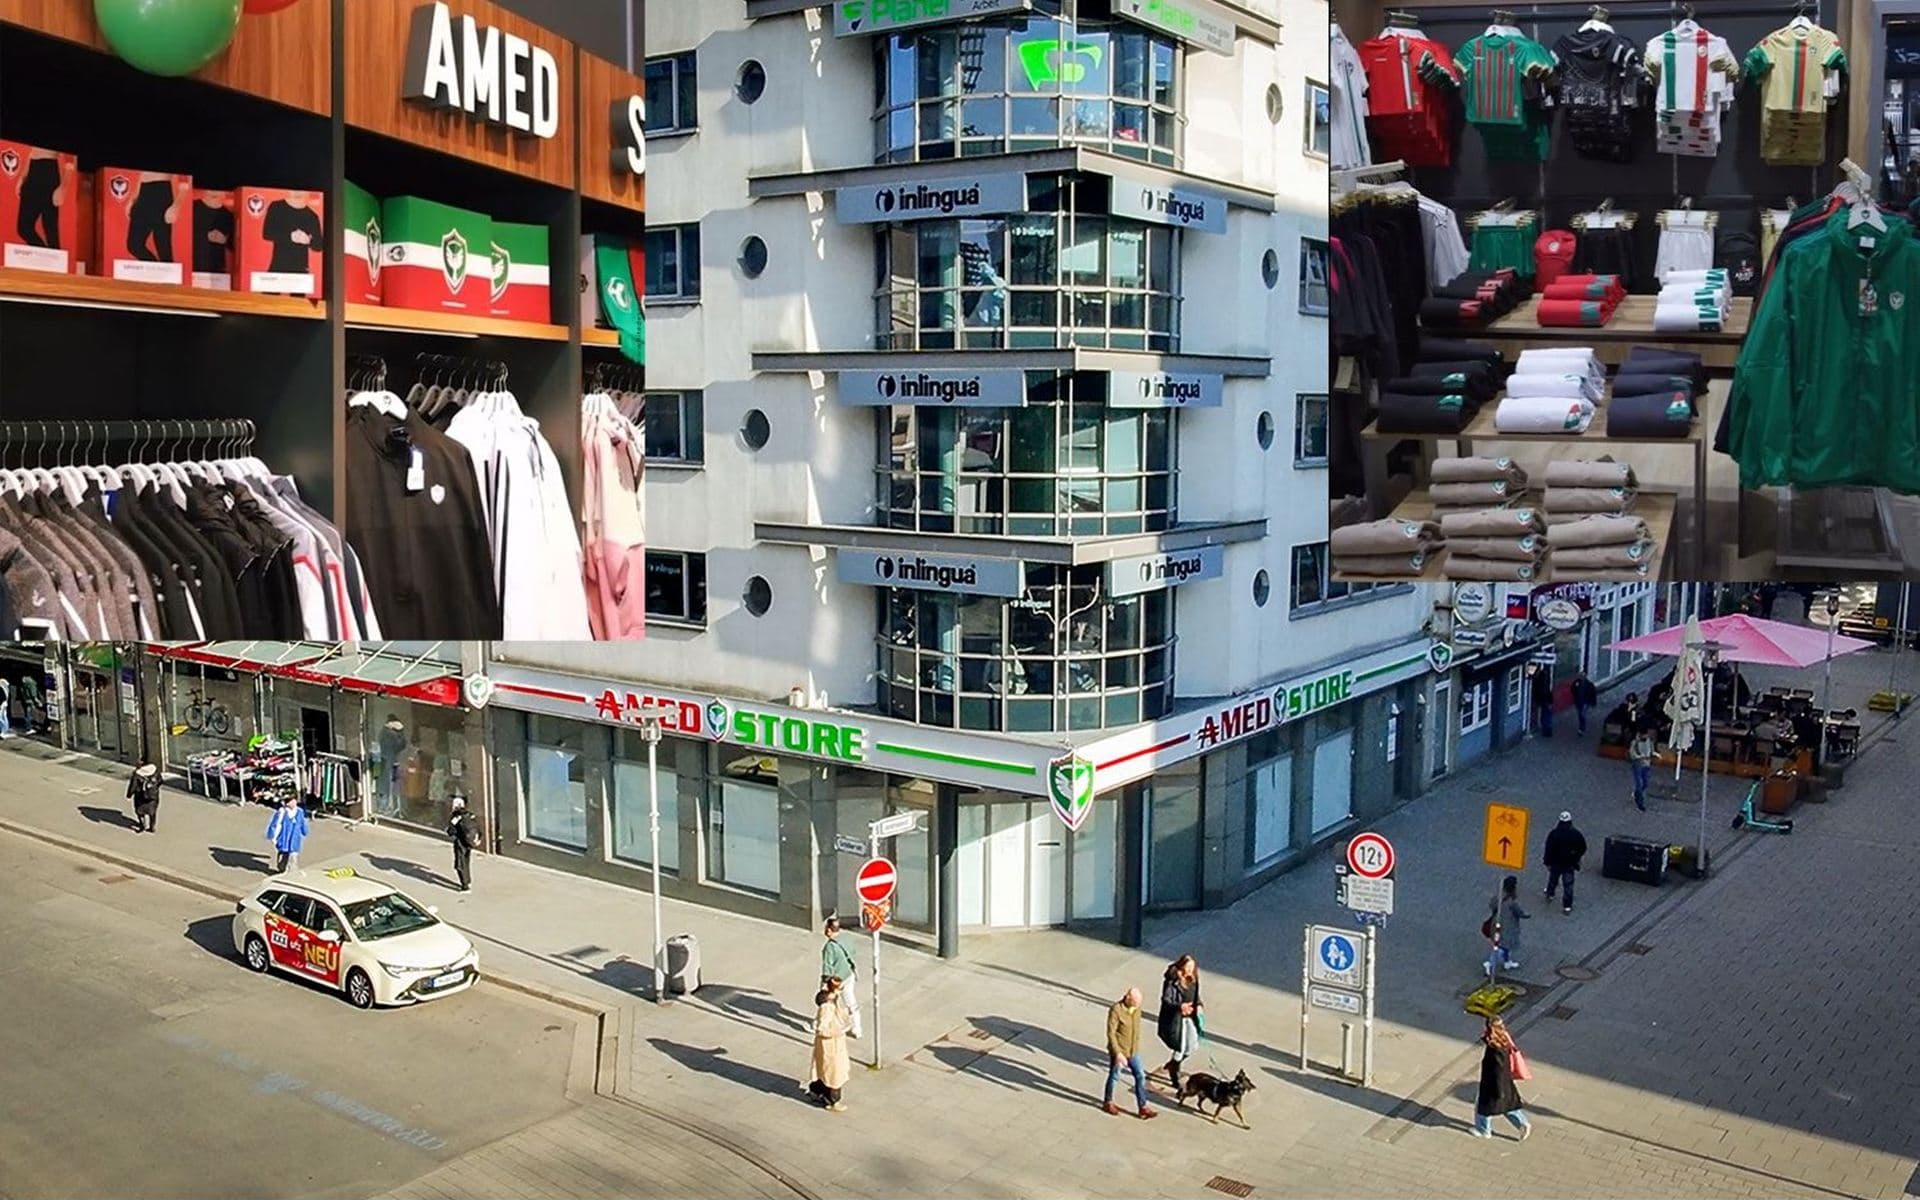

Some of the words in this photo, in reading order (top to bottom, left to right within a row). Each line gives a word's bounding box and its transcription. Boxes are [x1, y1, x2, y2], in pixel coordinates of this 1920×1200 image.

[423, 1, 559, 139] AMED
[899, 183, 980, 213] inlingua
[1156, 190, 1205, 222] inlingua
[900, 374, 979, 402] inlingua
[1153, 376, 1201, 400] inlingua
[898, 556, 976, 587] inlingua
[1154, 554, 1201, 581] inlingua
[595, 688, 702, 733] AMED
[733, 710, 863, 761] STORE
[1197, 698, 1271, 749] AMED
[1287, 671, 1352, 717] STORE
[304, 942, 337, 970] NEU
